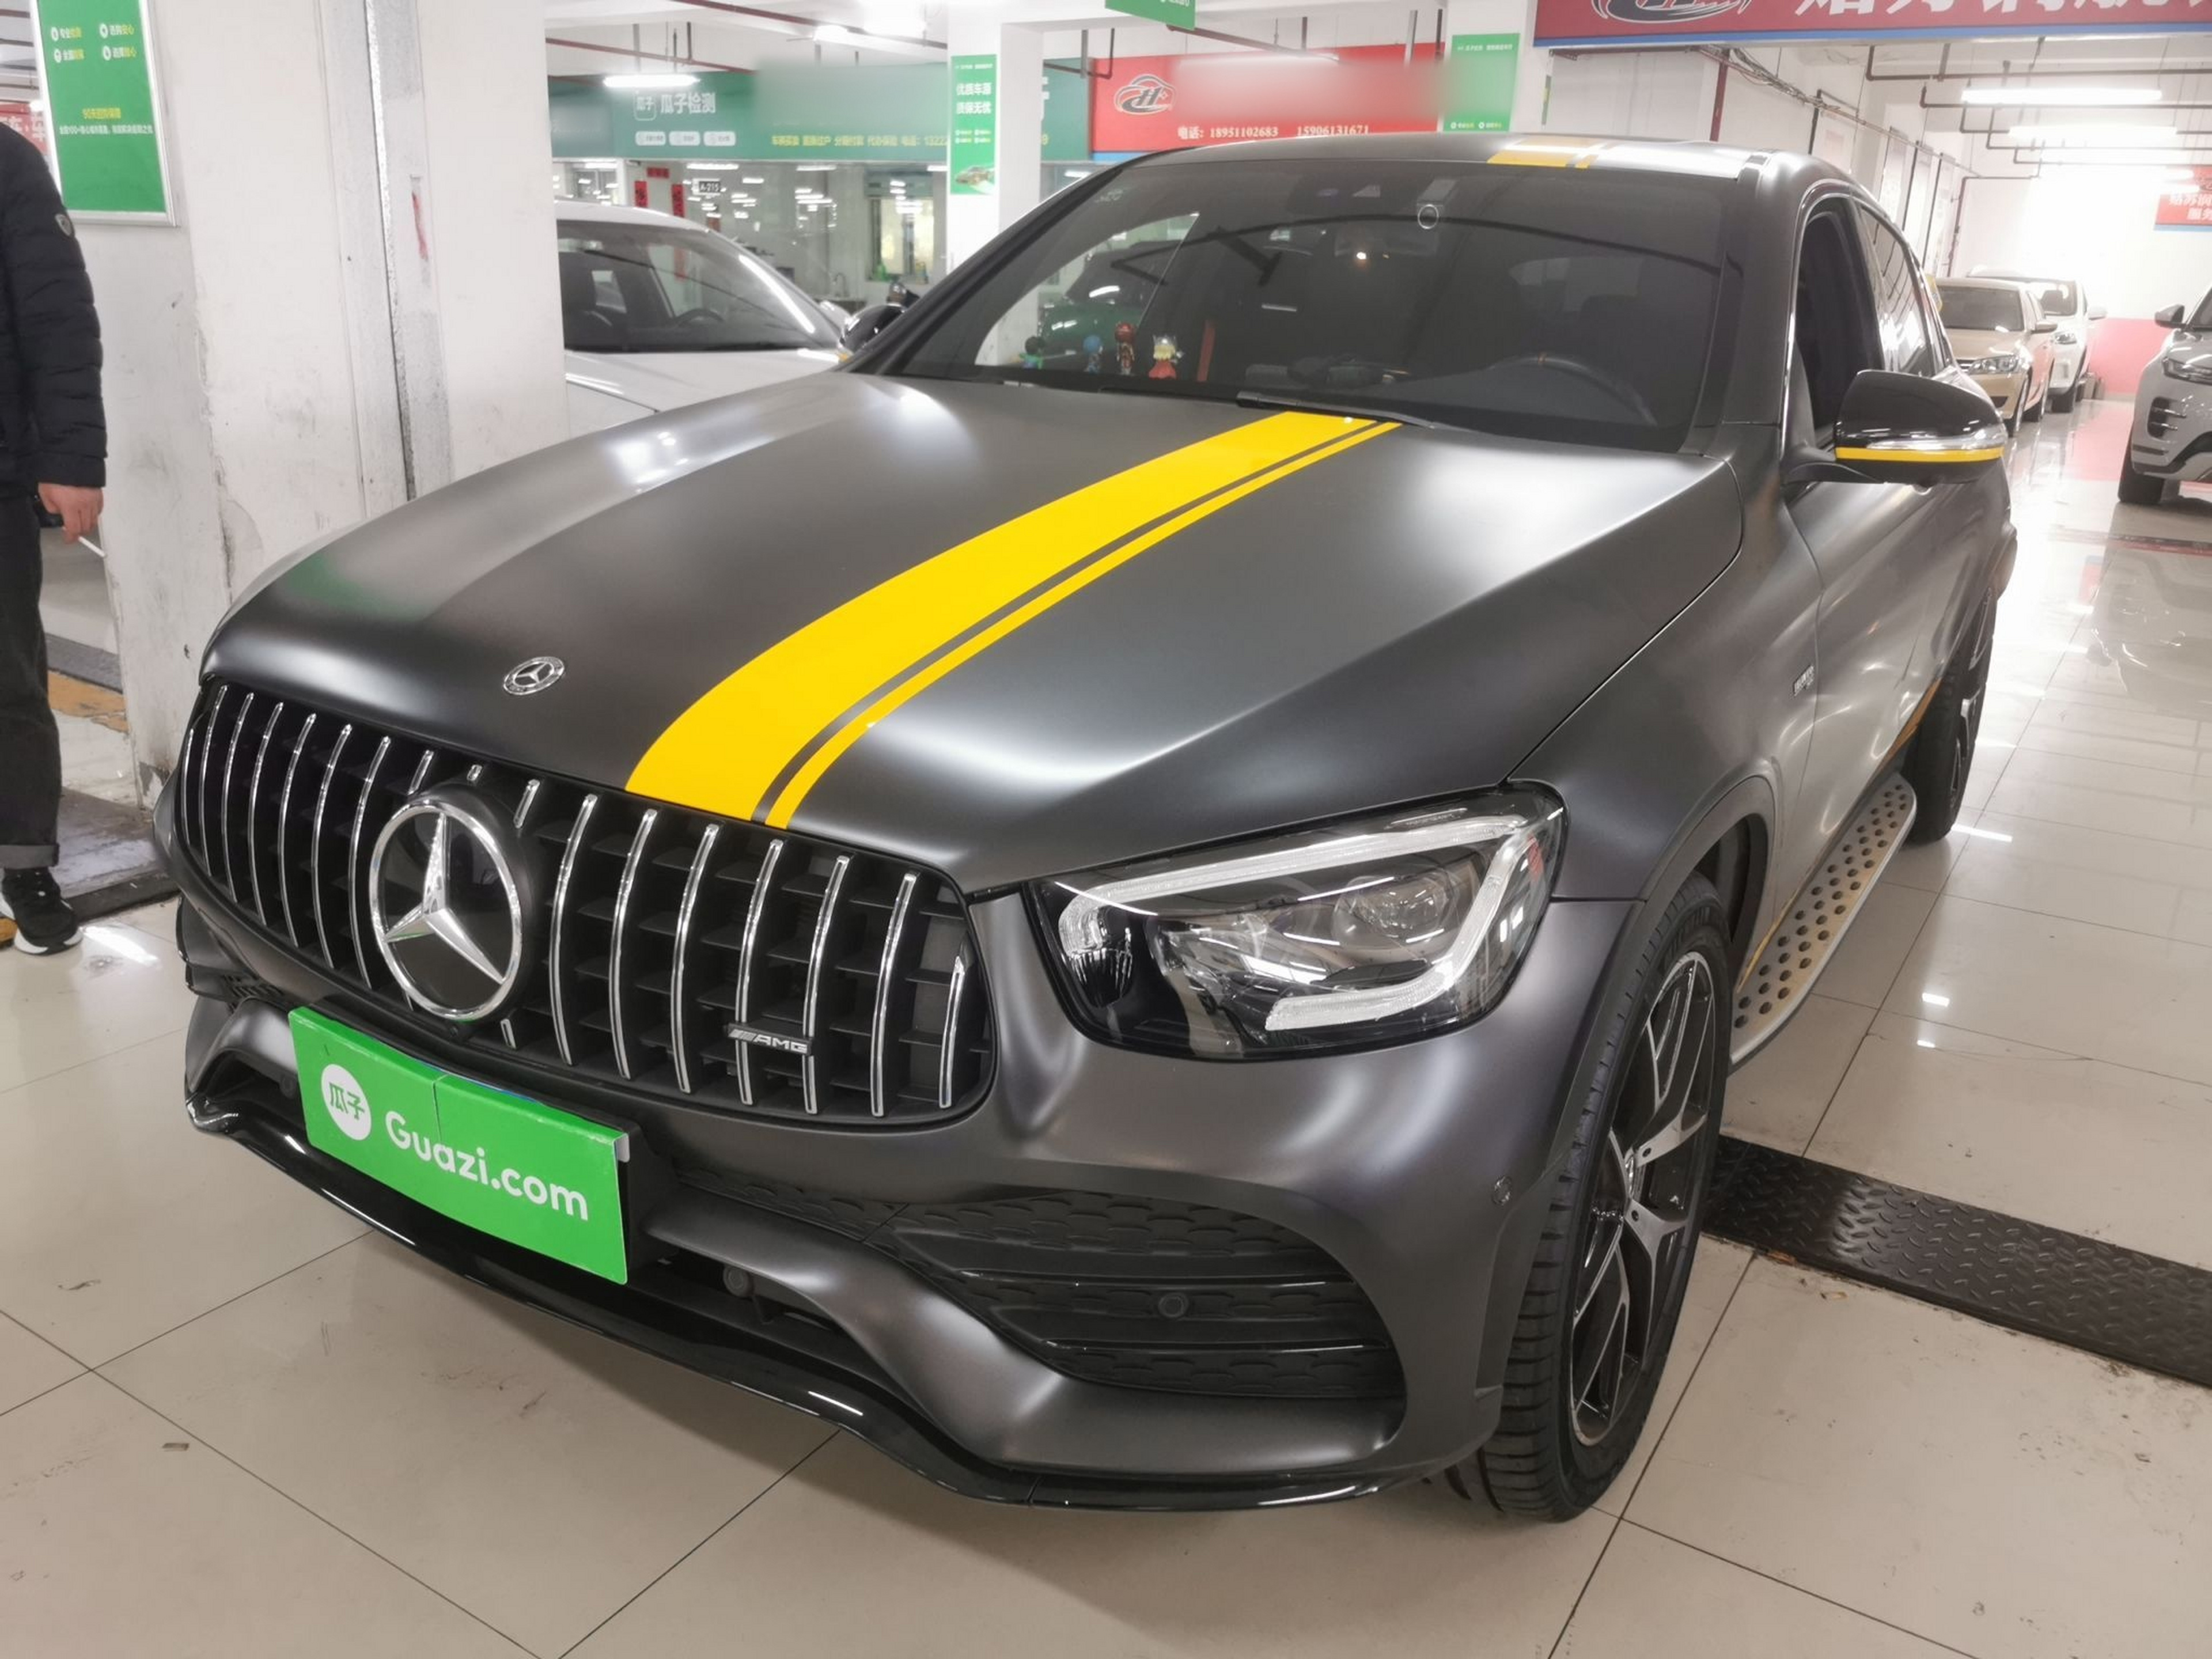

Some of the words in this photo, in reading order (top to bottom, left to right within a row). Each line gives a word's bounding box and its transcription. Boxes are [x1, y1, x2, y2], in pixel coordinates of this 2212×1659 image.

[661, 93, 716, 114] 瓜子检测
[1210, 126, 1279, 138] 18951102683
[753, 1034, 808, 1054] AMG
[329, 1082, 365, 1120] 瓜子
[385, 1110, 589, 1222] Guazi.com
